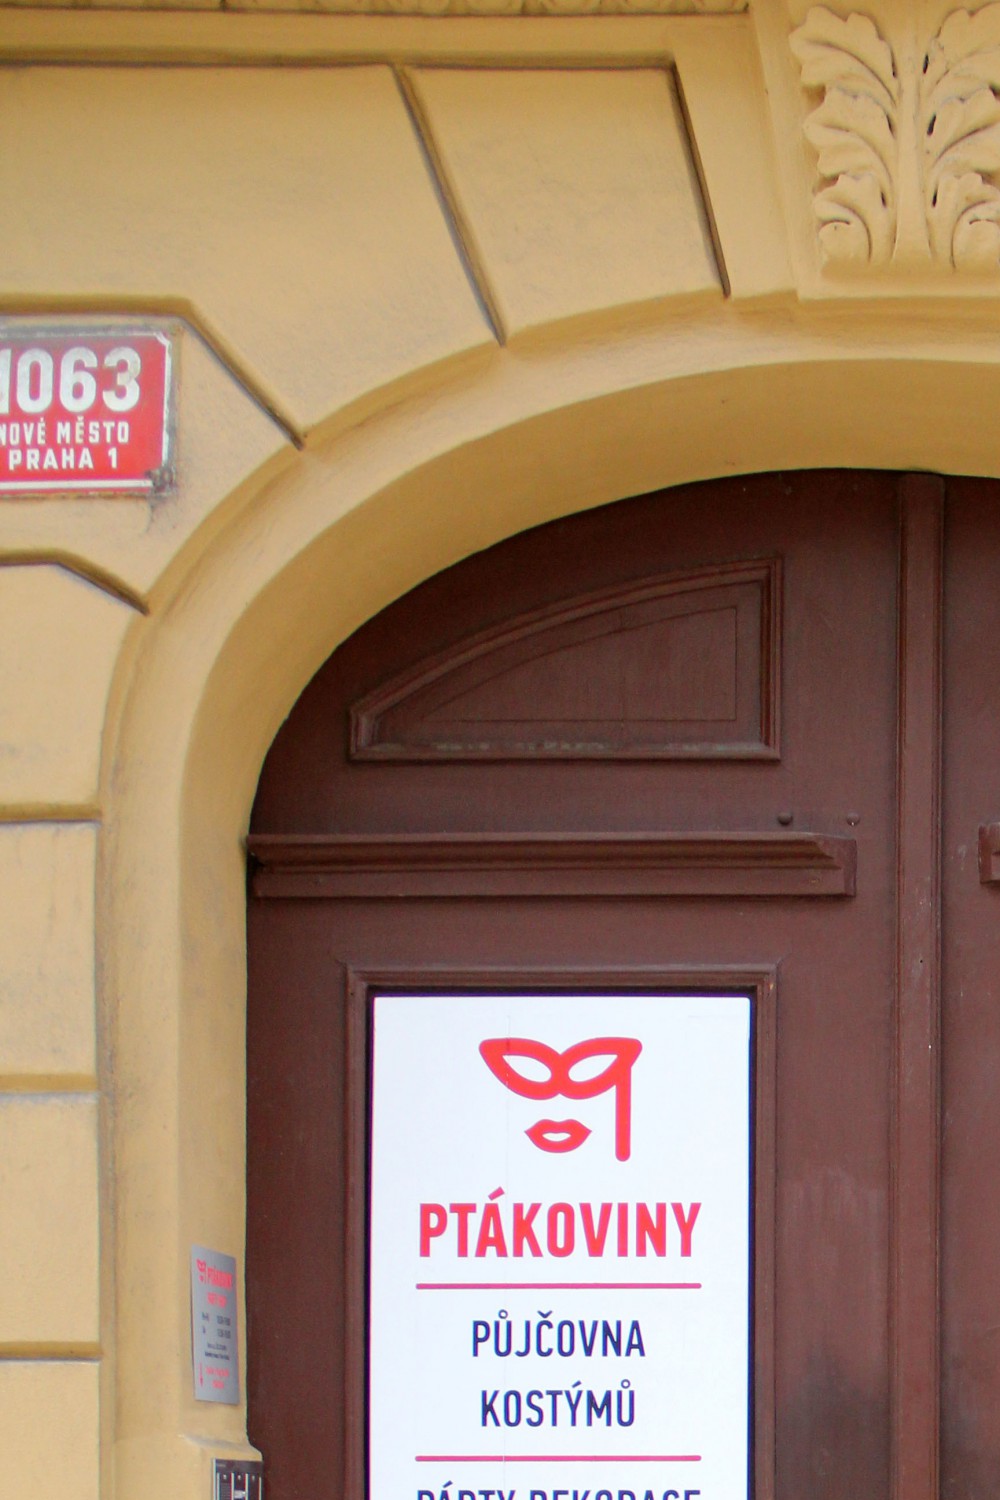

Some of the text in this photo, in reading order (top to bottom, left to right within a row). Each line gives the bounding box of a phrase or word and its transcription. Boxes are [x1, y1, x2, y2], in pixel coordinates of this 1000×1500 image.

[57, 416, 130, 444] MĚSTO
[8, 447, 117, 470] PRAHA 1
[419, 1186, 702, 1258] PTÁKOVINY
[471, 1309, 646, 1357] PŮJČOVNA
[480, 1379, 636, 1427] KOSTÝMŮ
